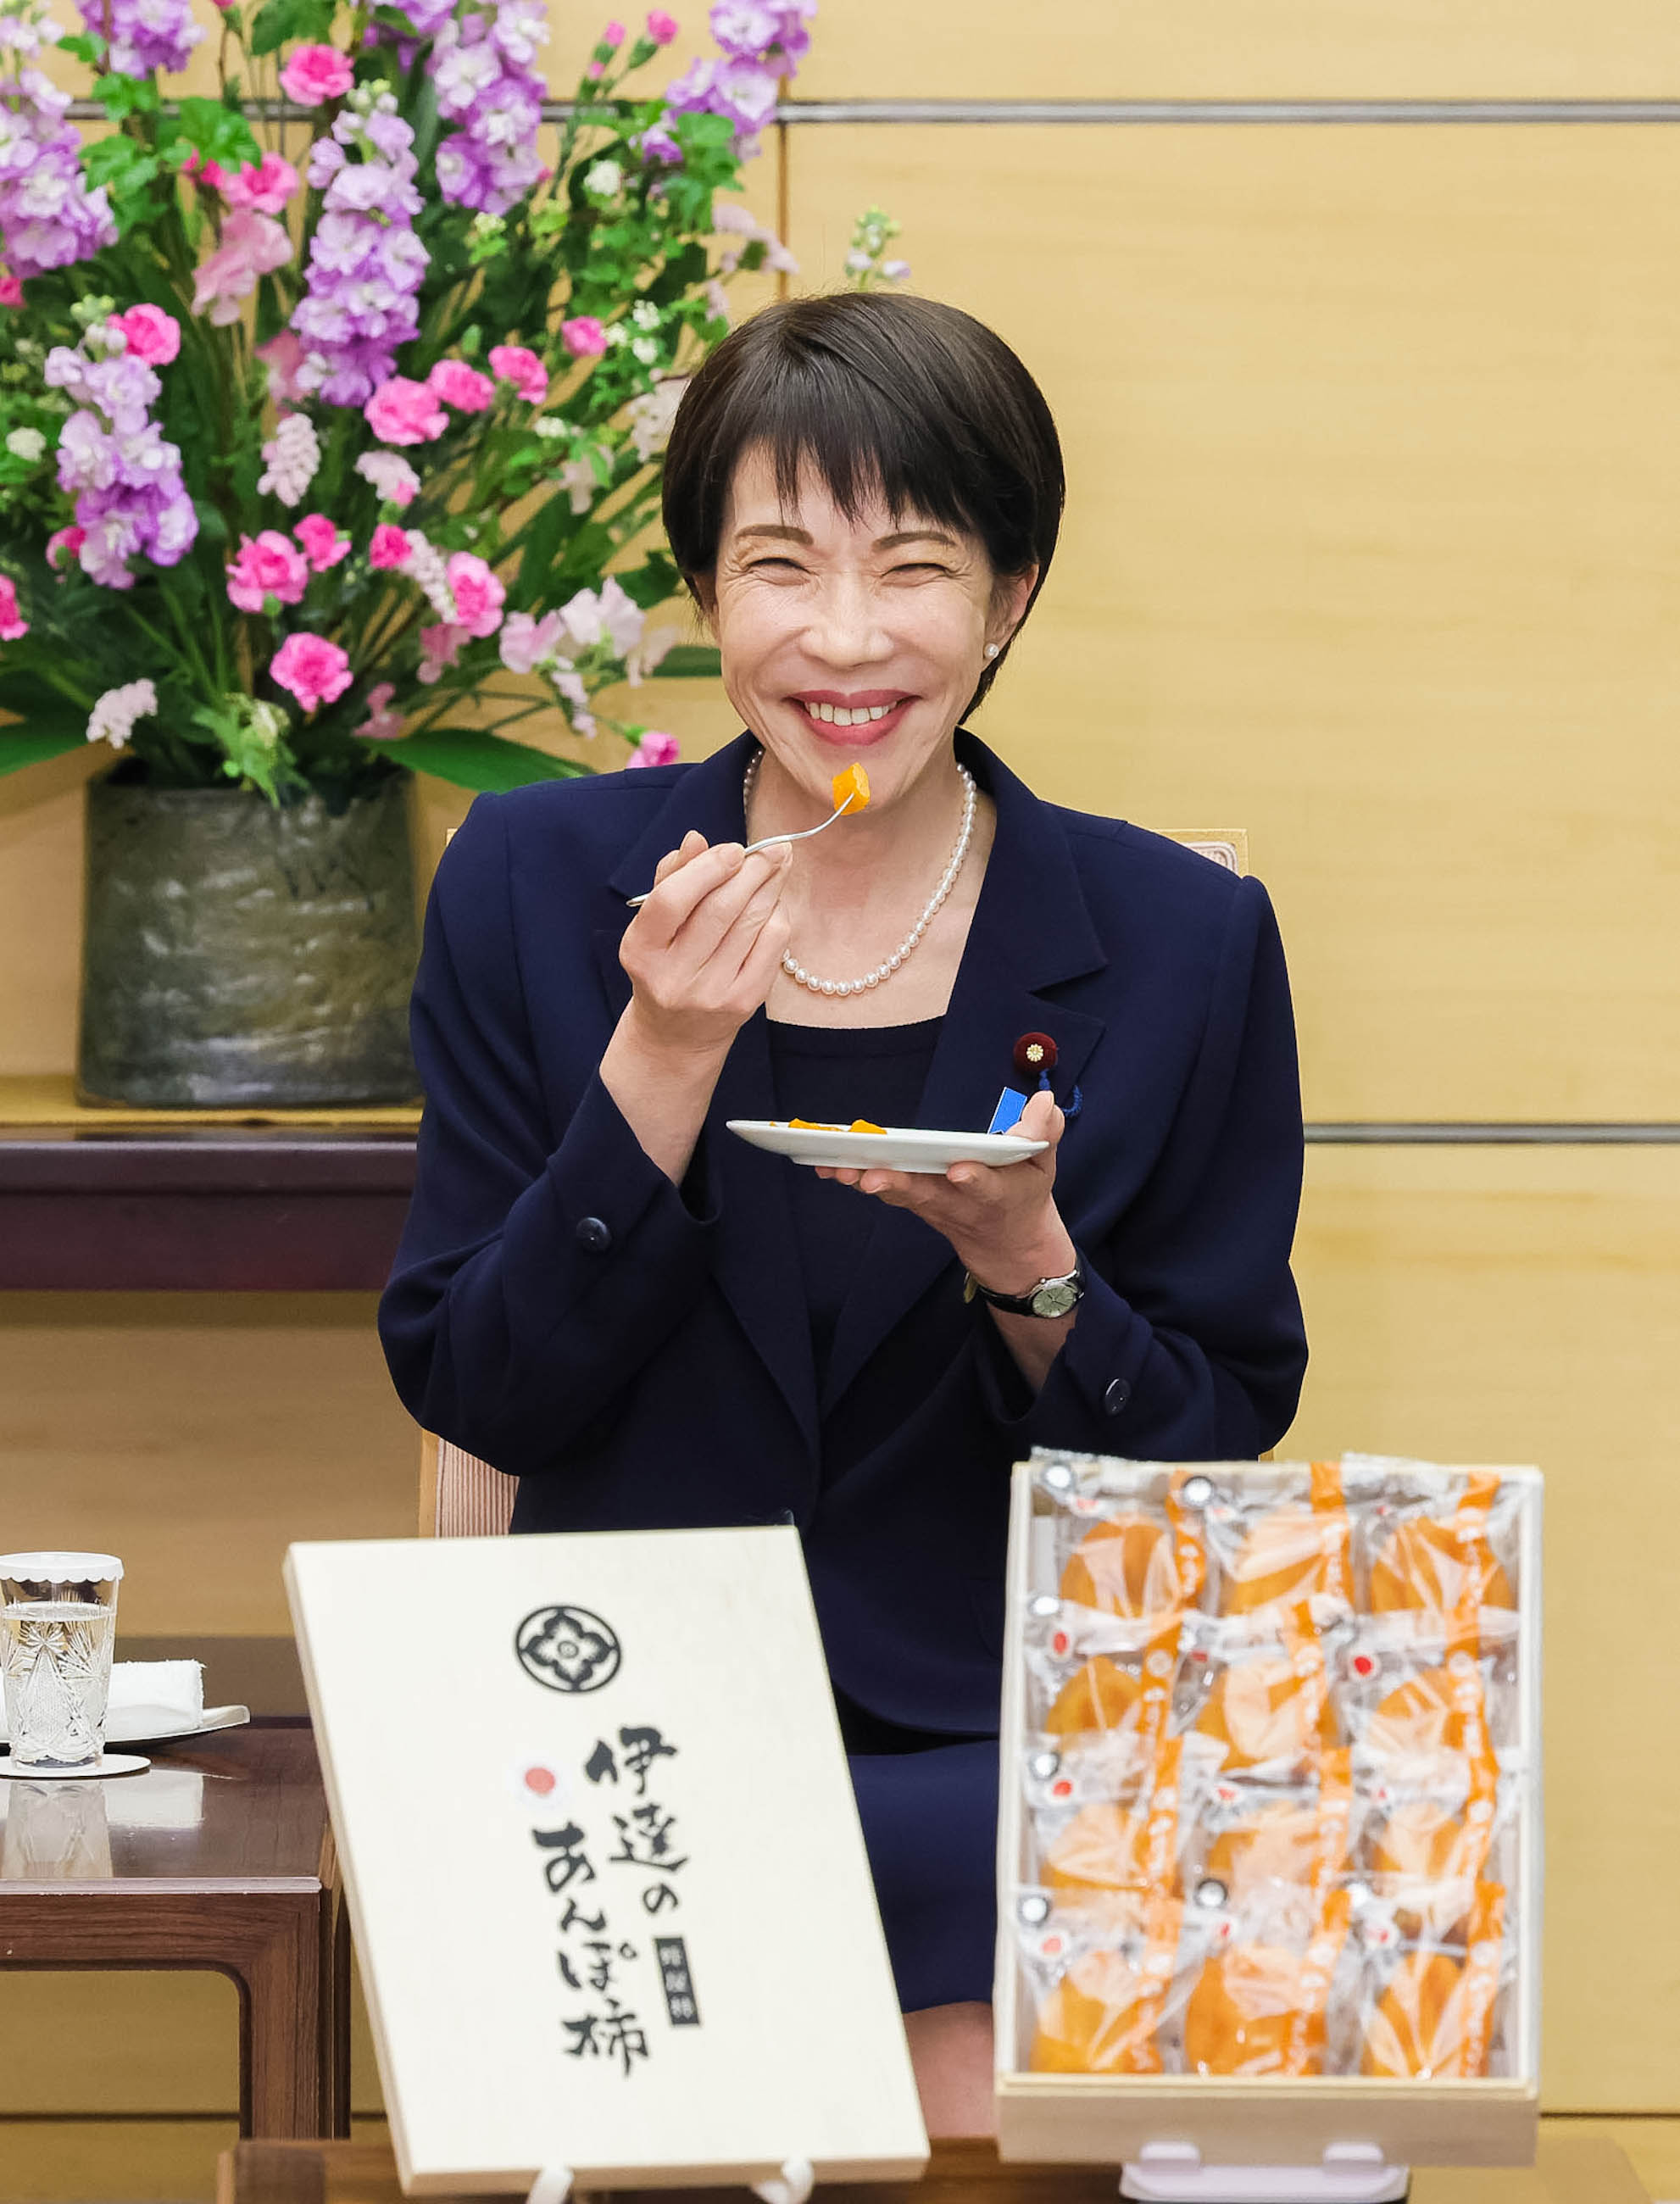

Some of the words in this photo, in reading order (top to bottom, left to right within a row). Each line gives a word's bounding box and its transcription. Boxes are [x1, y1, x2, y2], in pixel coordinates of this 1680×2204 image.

[584, 1726, 688, 1914] 伊達の
[531, 1821, 649, 2076] あんぽ柿
